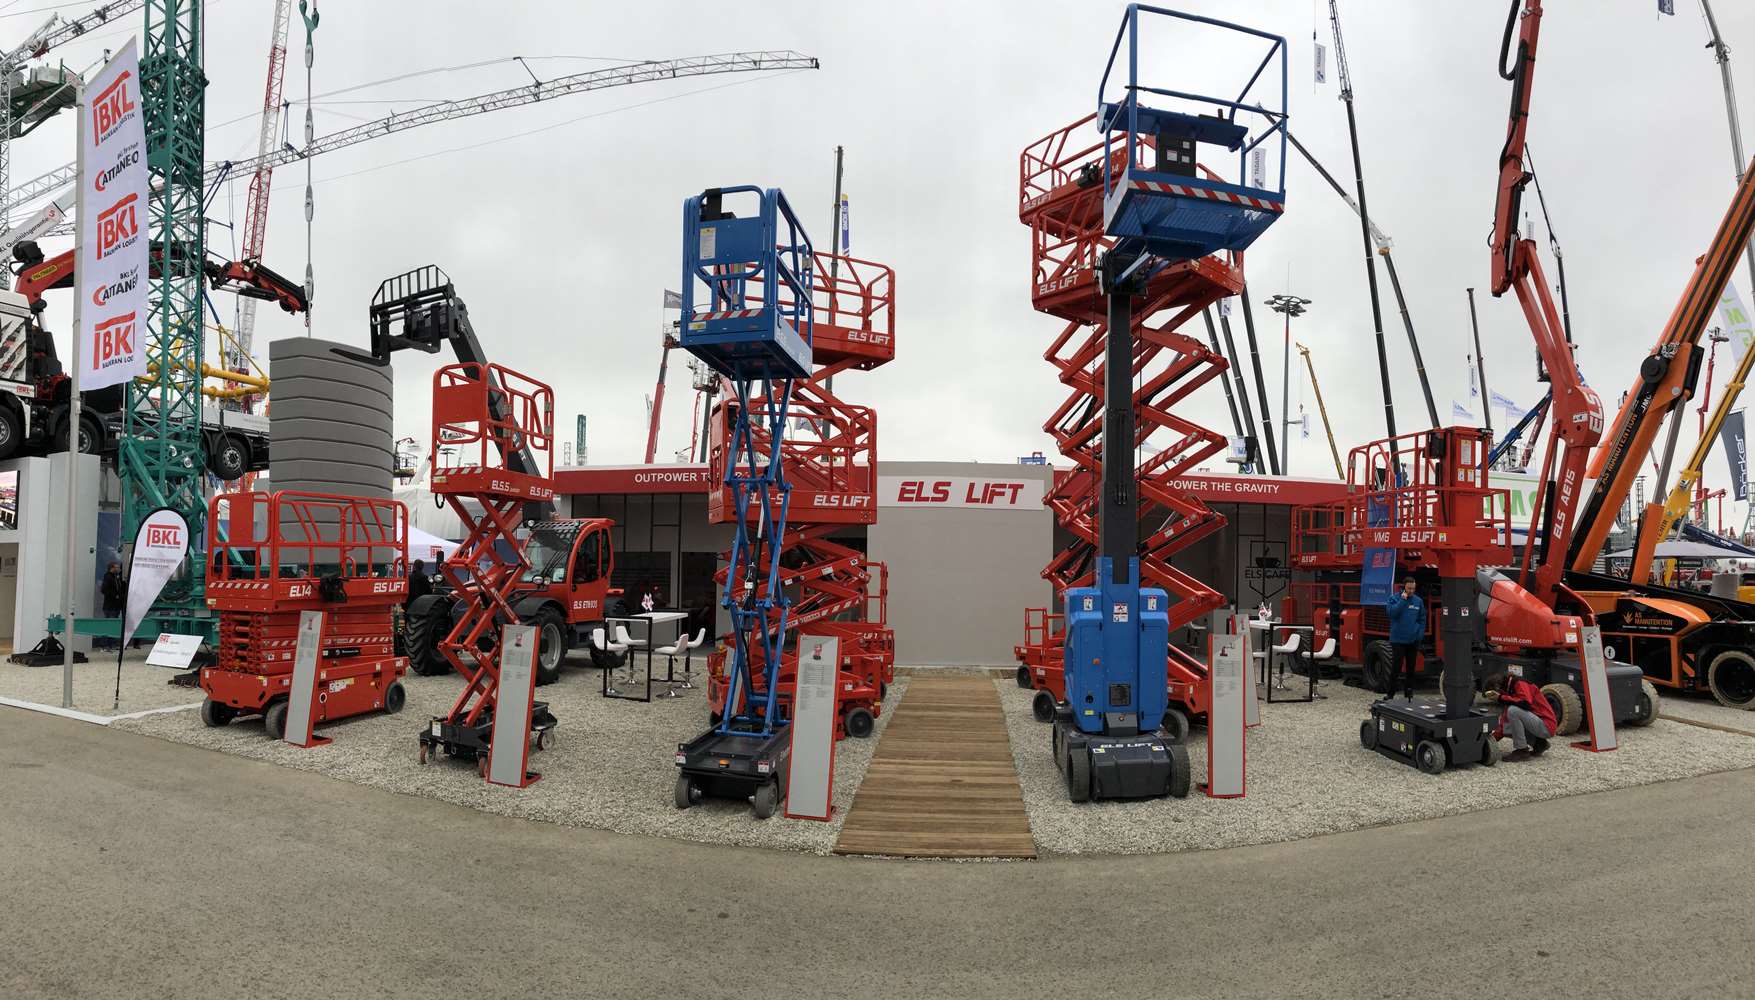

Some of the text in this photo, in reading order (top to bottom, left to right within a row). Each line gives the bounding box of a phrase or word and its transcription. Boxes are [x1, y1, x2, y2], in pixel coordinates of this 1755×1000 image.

[99, 83, 135, 135] BKL
[95, 150, 139, 192] CATTANEO
[103, 205, 138, 249] BKL
[1040, 275, 1079, 295] ELS LIFT
[103, 322, 135, 361] BK
[848, 330, 890, 345] ELS LIFT
[634, 472, 698, 483] OUTPOWER
[529, 486, 541, 497] ELS
[541, 488, 553, 498] LIFT
[897, 481, 1025, 505] ELS LIFT
[1210, 481, 1232, 492] THE
[1234, 483, 1280, 494] GRAVITY
[813, 494, 871, 507] ELS LIFT
[1553, 509, 1566, 540] ELS
[151, 529, 181, 546] BKL
[1400, 531, 1417, 543] ELS
[1417, 530, 1436, 543] LIFT
[1244, 569, 1262, 579] ELS
[289, 584, 313, 598] EL14
[373, 580, 406, 593] ELS LIFT
